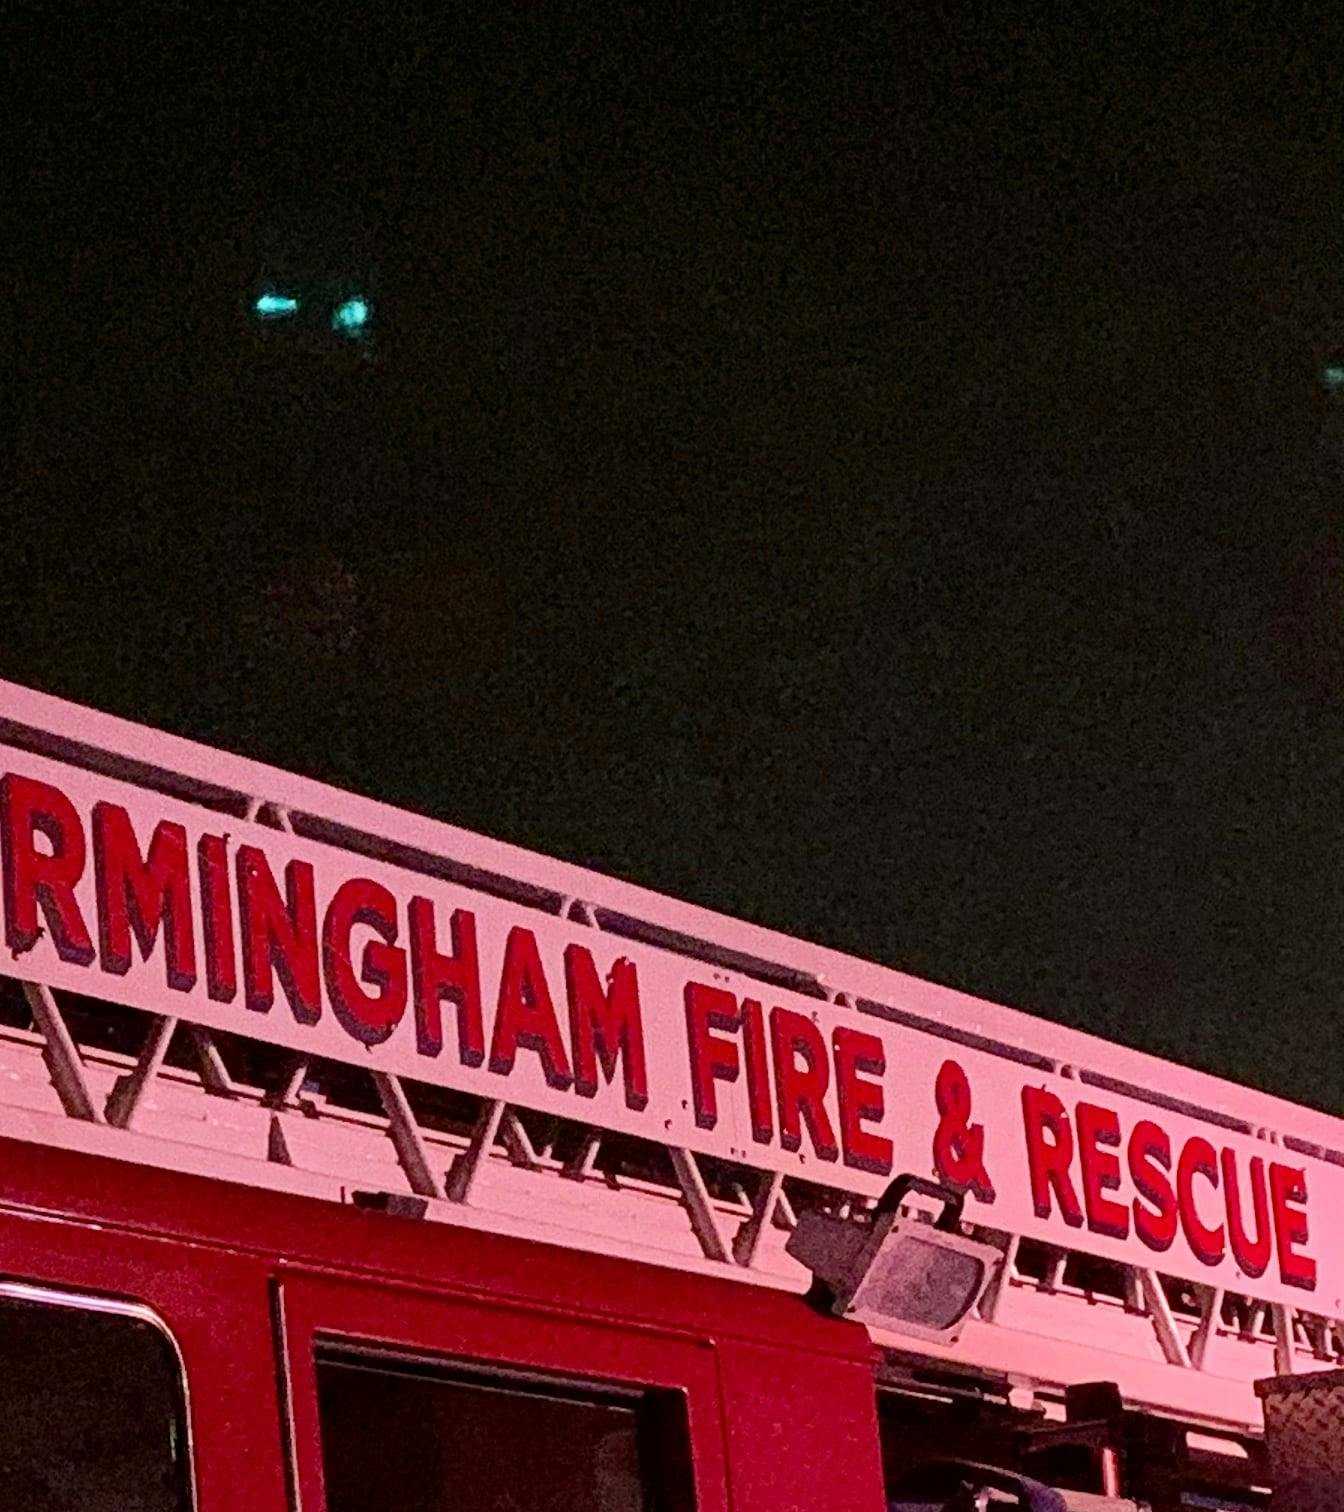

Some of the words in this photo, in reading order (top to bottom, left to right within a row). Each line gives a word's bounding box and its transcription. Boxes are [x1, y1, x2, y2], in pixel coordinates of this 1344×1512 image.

[683, 980, 895, 1177] FIRE
[931, 1058, 997, 1205] &
[1020, 1083, 1318, 1291] RESCUE
